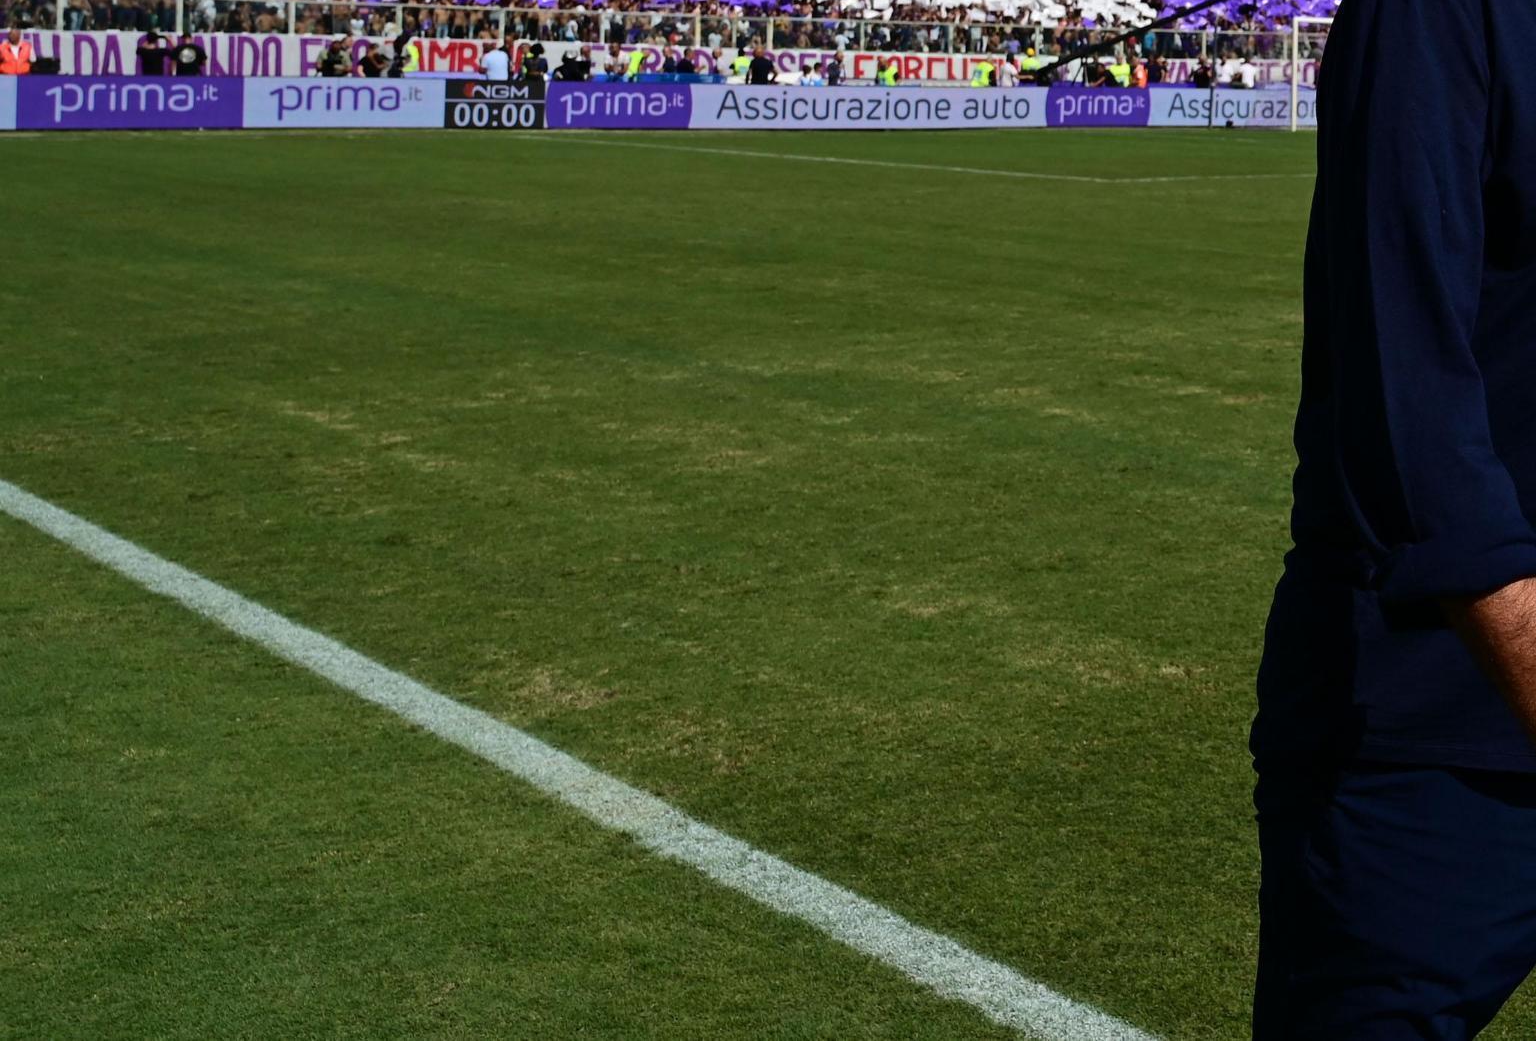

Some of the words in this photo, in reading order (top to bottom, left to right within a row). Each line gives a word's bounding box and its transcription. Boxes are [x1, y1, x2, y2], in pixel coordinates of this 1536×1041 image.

[45, 83, 218, 122] prima.it
[471, 85, 529, 99] NGM
[716, 90, 951, 120] Assicurazione
[963, 95, 1030, 119] auto
[1168, 93, 1317, 119] Assicurazo
[453, 102, 536, 127] 00:00
[560, 91, 684, 124] prima.it
